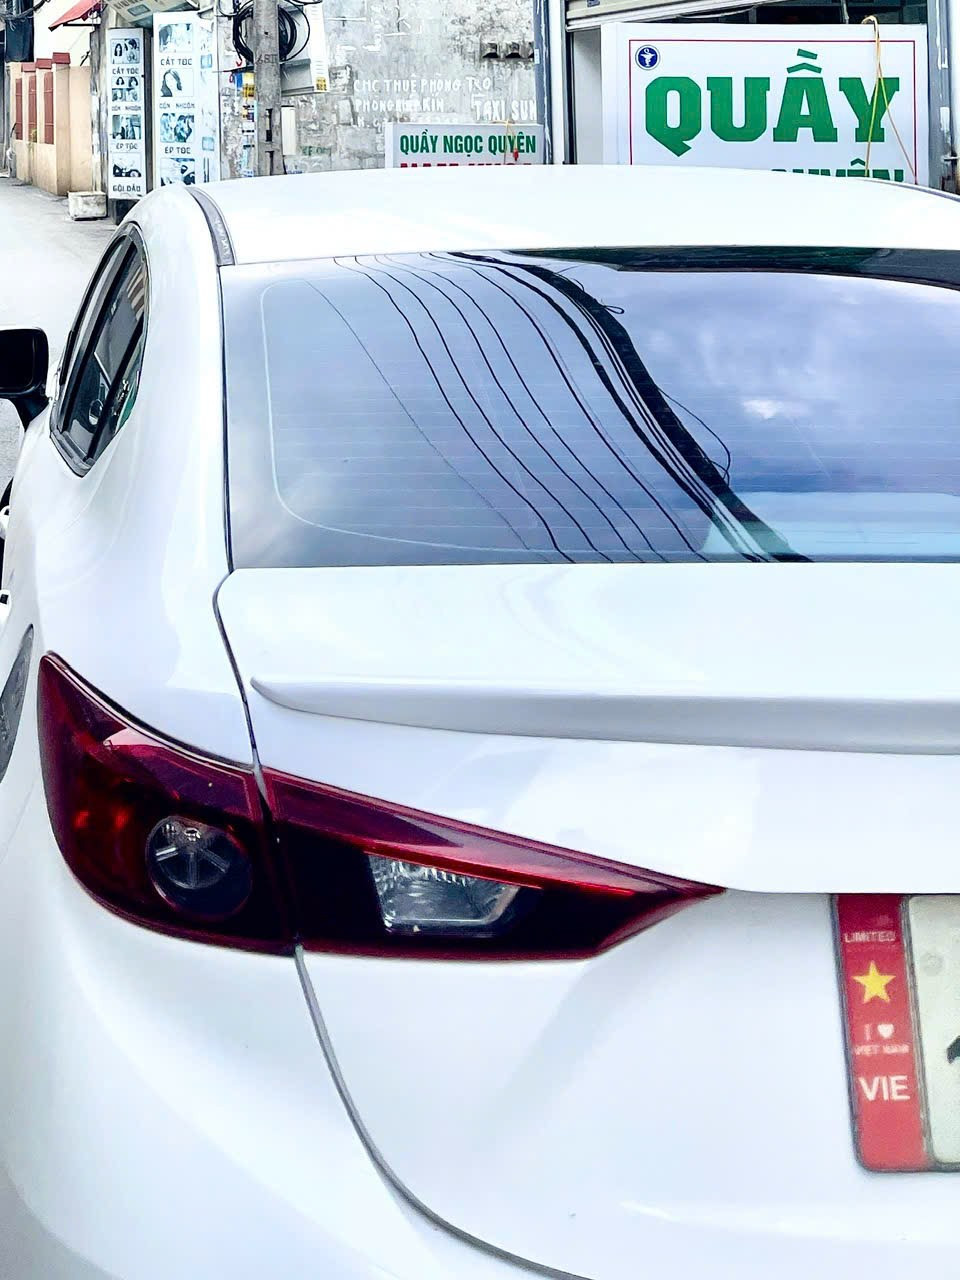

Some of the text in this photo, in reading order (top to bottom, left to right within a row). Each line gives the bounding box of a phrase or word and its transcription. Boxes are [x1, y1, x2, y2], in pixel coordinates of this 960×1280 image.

[474, 99, 506, 121] TAXI
[645, 48, 900, 157] QUẦY
[400, 128, 536, 157] QUẦY NGỌC QUYÊN
[859, 1074, 910, 1101] VIE
